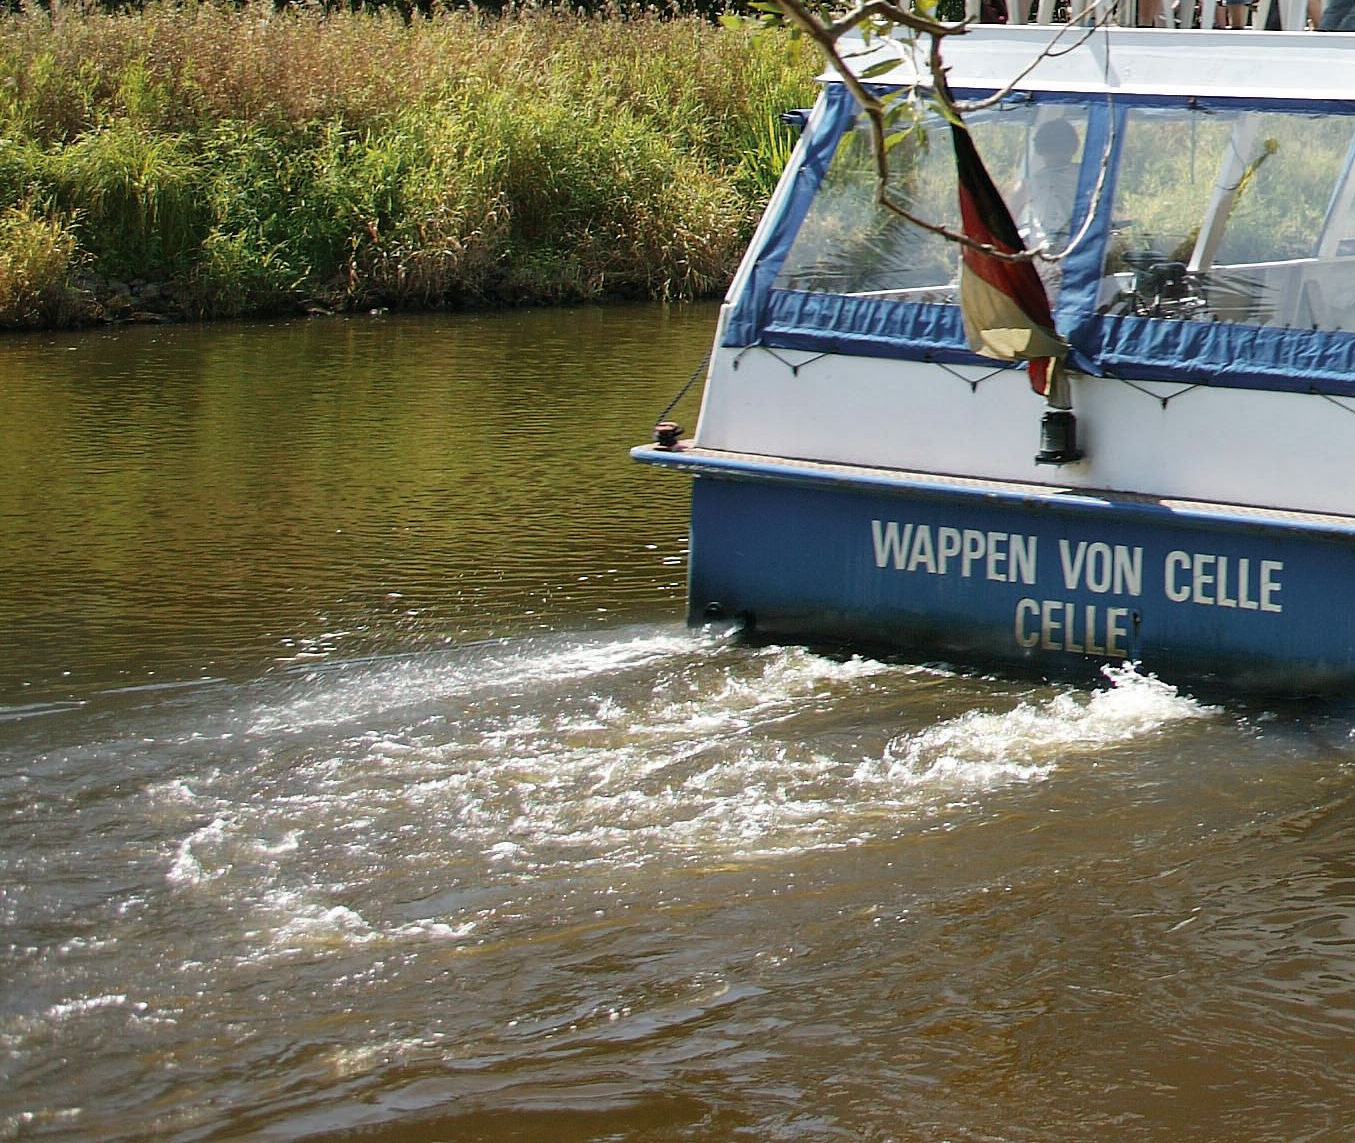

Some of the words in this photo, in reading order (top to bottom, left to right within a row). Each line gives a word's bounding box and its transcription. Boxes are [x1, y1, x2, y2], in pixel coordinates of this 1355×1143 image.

[871, 520, 1038, 585] WAPPEN
[1059, 539, 1143, 597] VON
[1164, 550, 1283, 613] CELLE
[1015, 597, 1129, 657] CELLE
